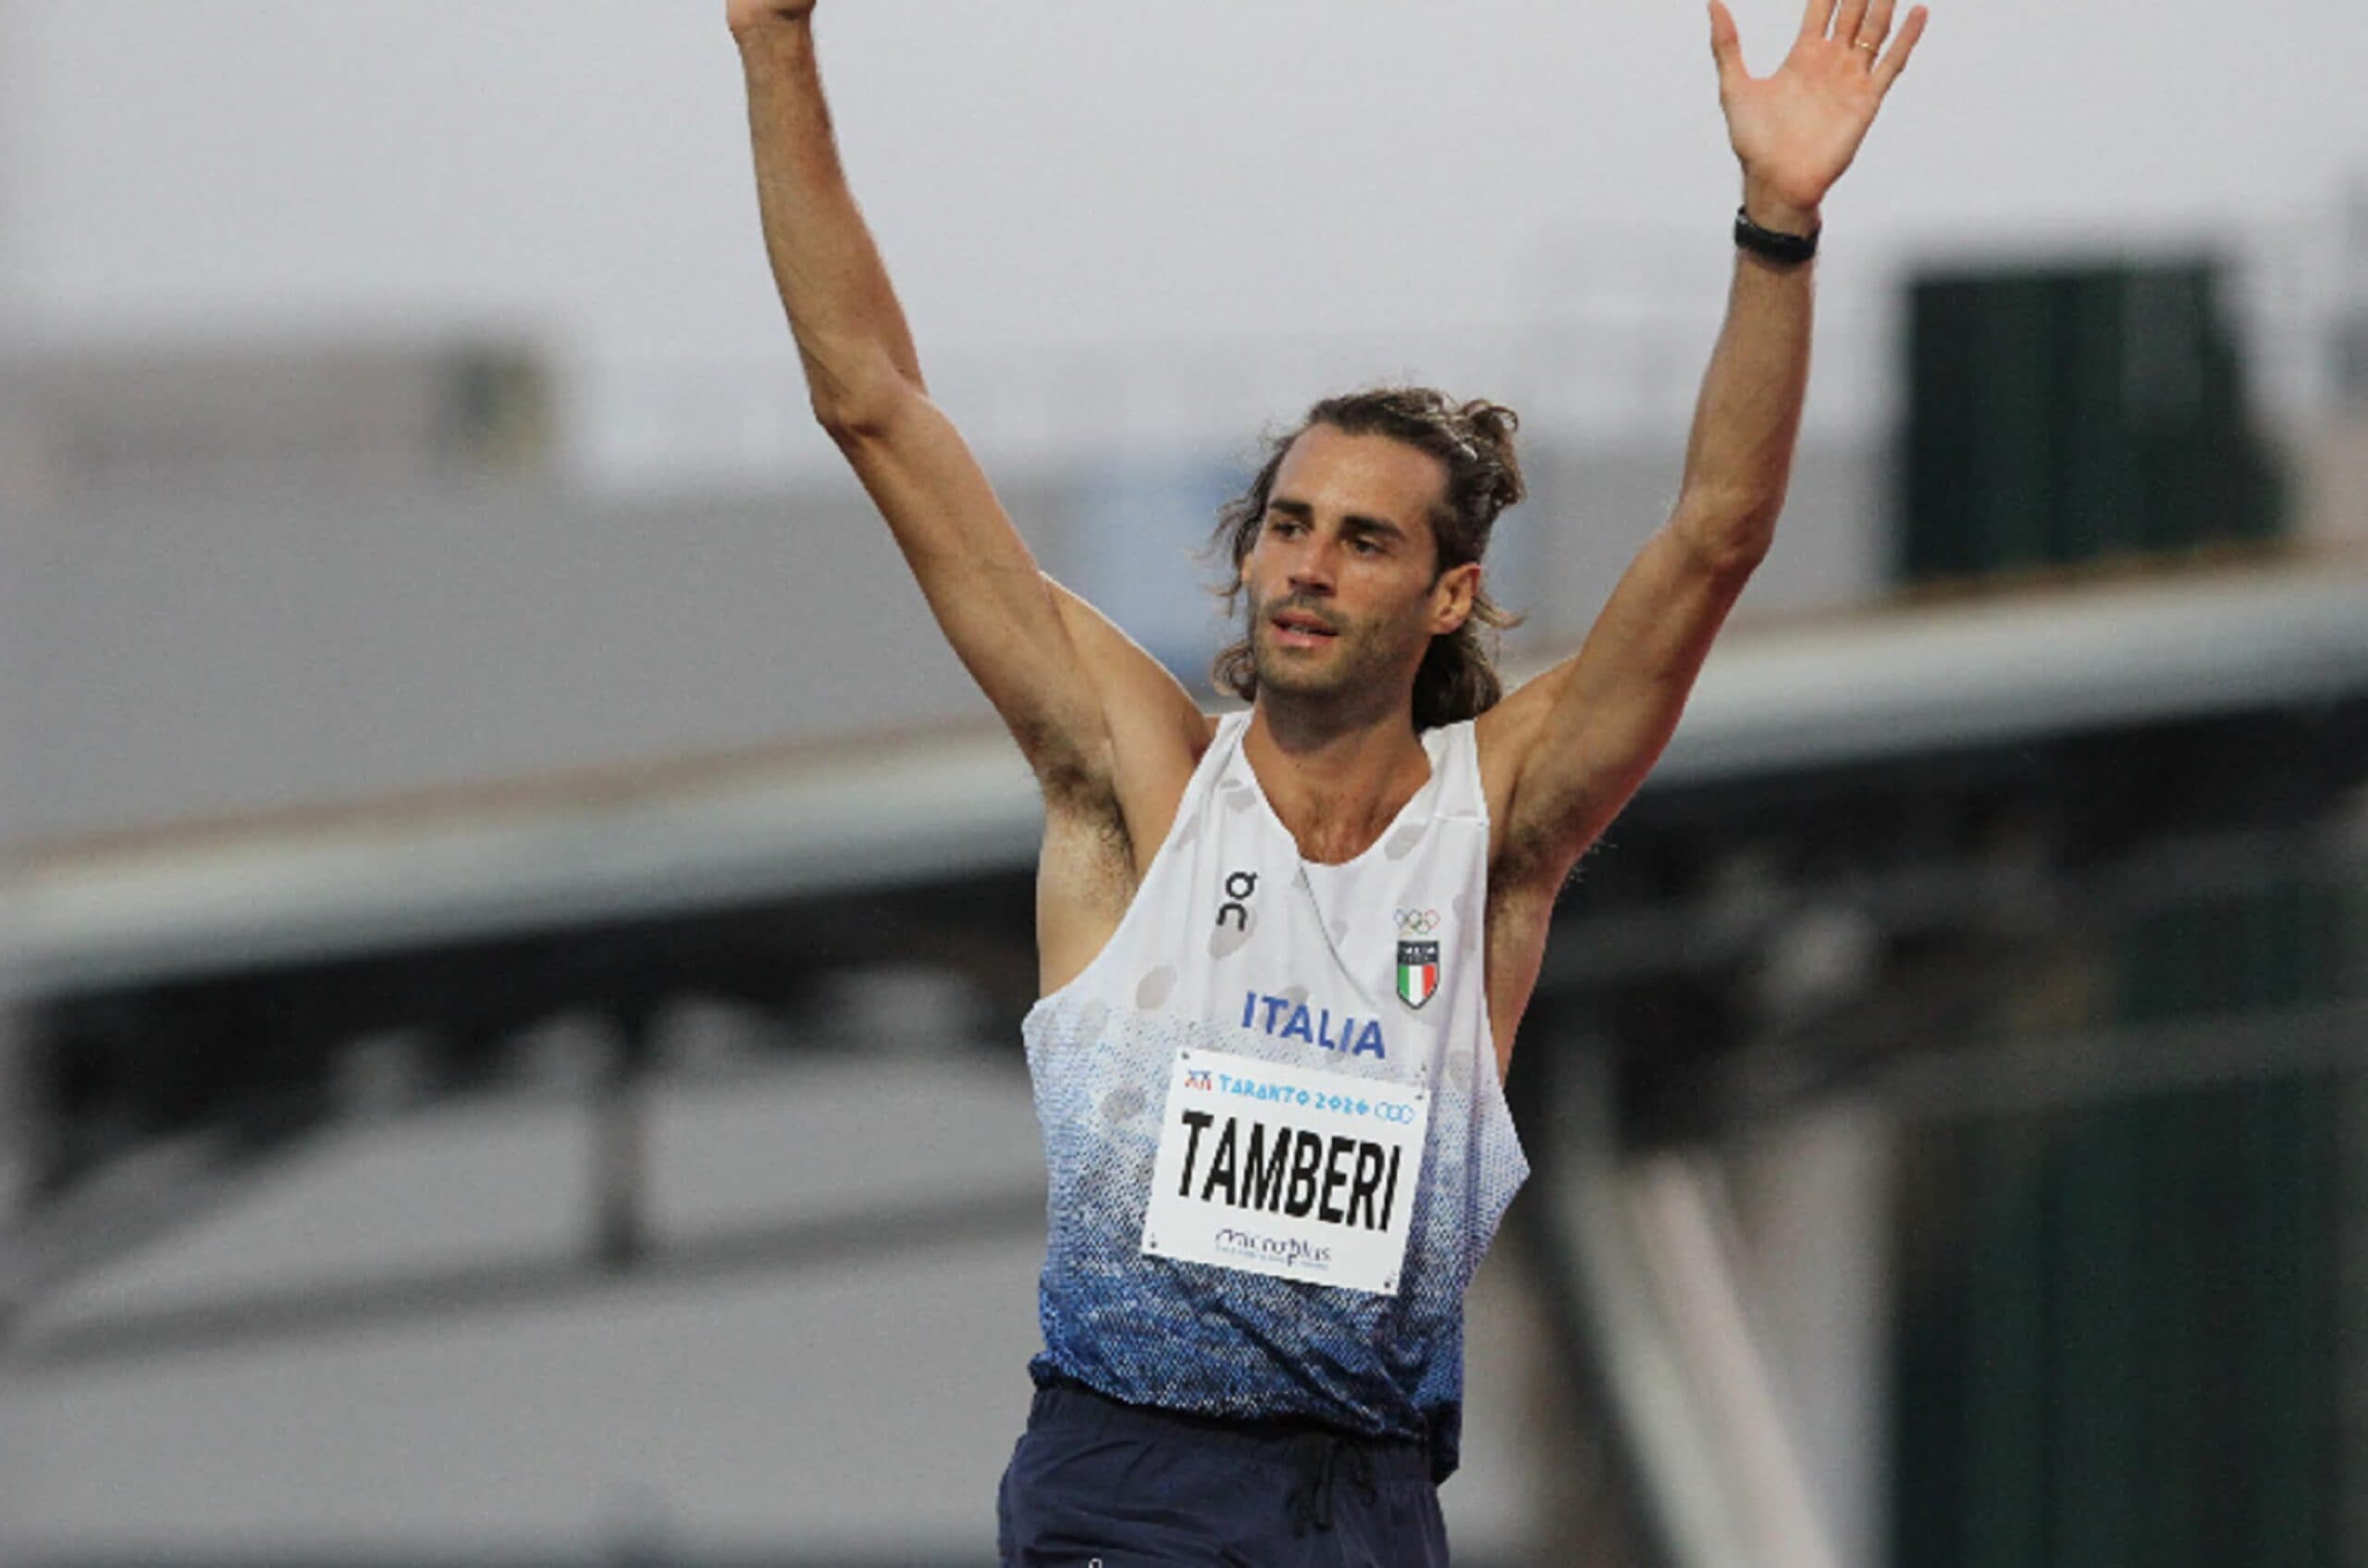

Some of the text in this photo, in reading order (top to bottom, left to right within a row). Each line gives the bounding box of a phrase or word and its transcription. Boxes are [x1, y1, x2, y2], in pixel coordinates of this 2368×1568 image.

[1241, 991, 1386, 1059] ITALIA
[1219, 1074, 1310, 1105] TARANTO
[1314, 1093, 1369, 1116] 2026
[1178, 1110, 1401, 1232] TAMBERI
